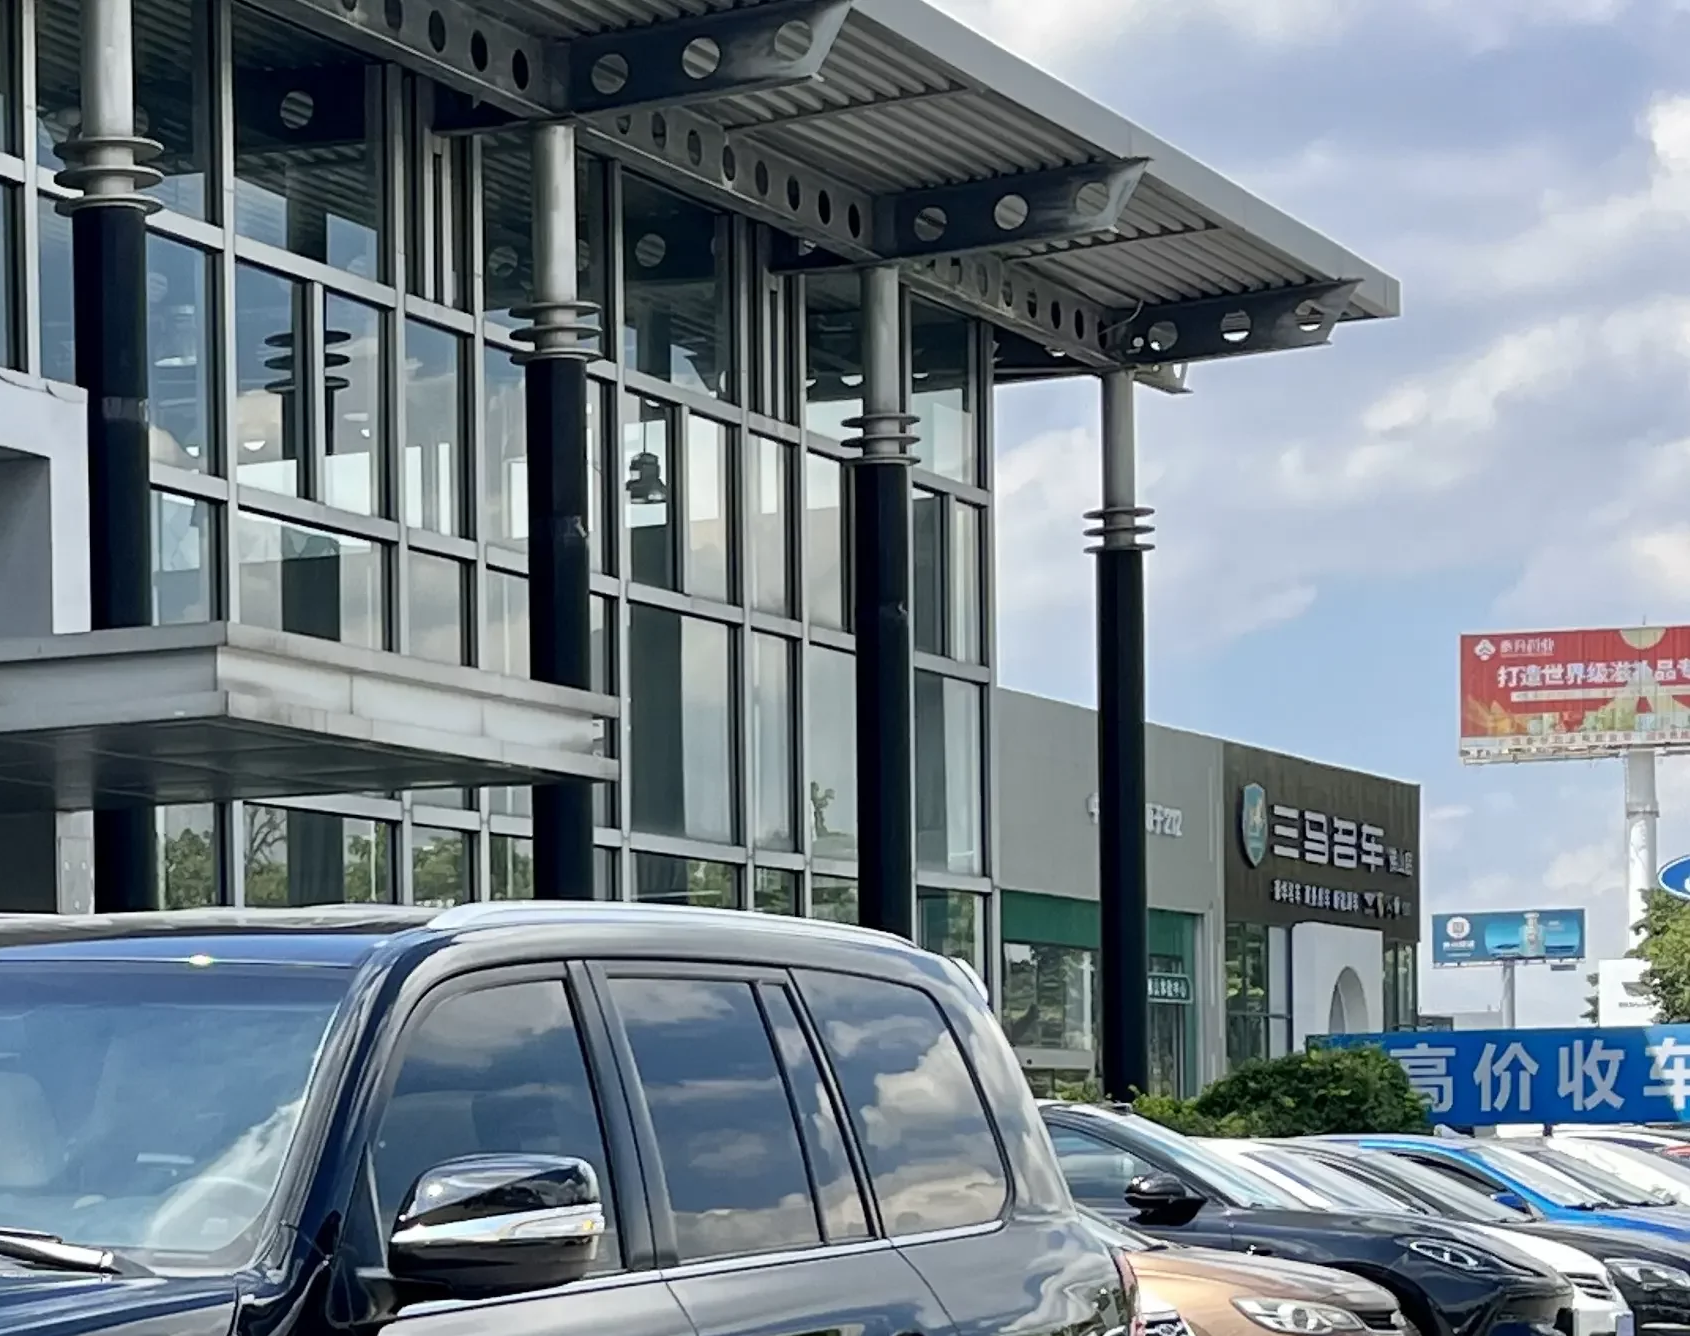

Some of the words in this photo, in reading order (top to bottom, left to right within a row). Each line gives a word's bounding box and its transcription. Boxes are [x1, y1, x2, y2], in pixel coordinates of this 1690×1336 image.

[1273, 804, 1385, 874] 三马名车
[1390, 1037, 1690, 1113] 高价收车
